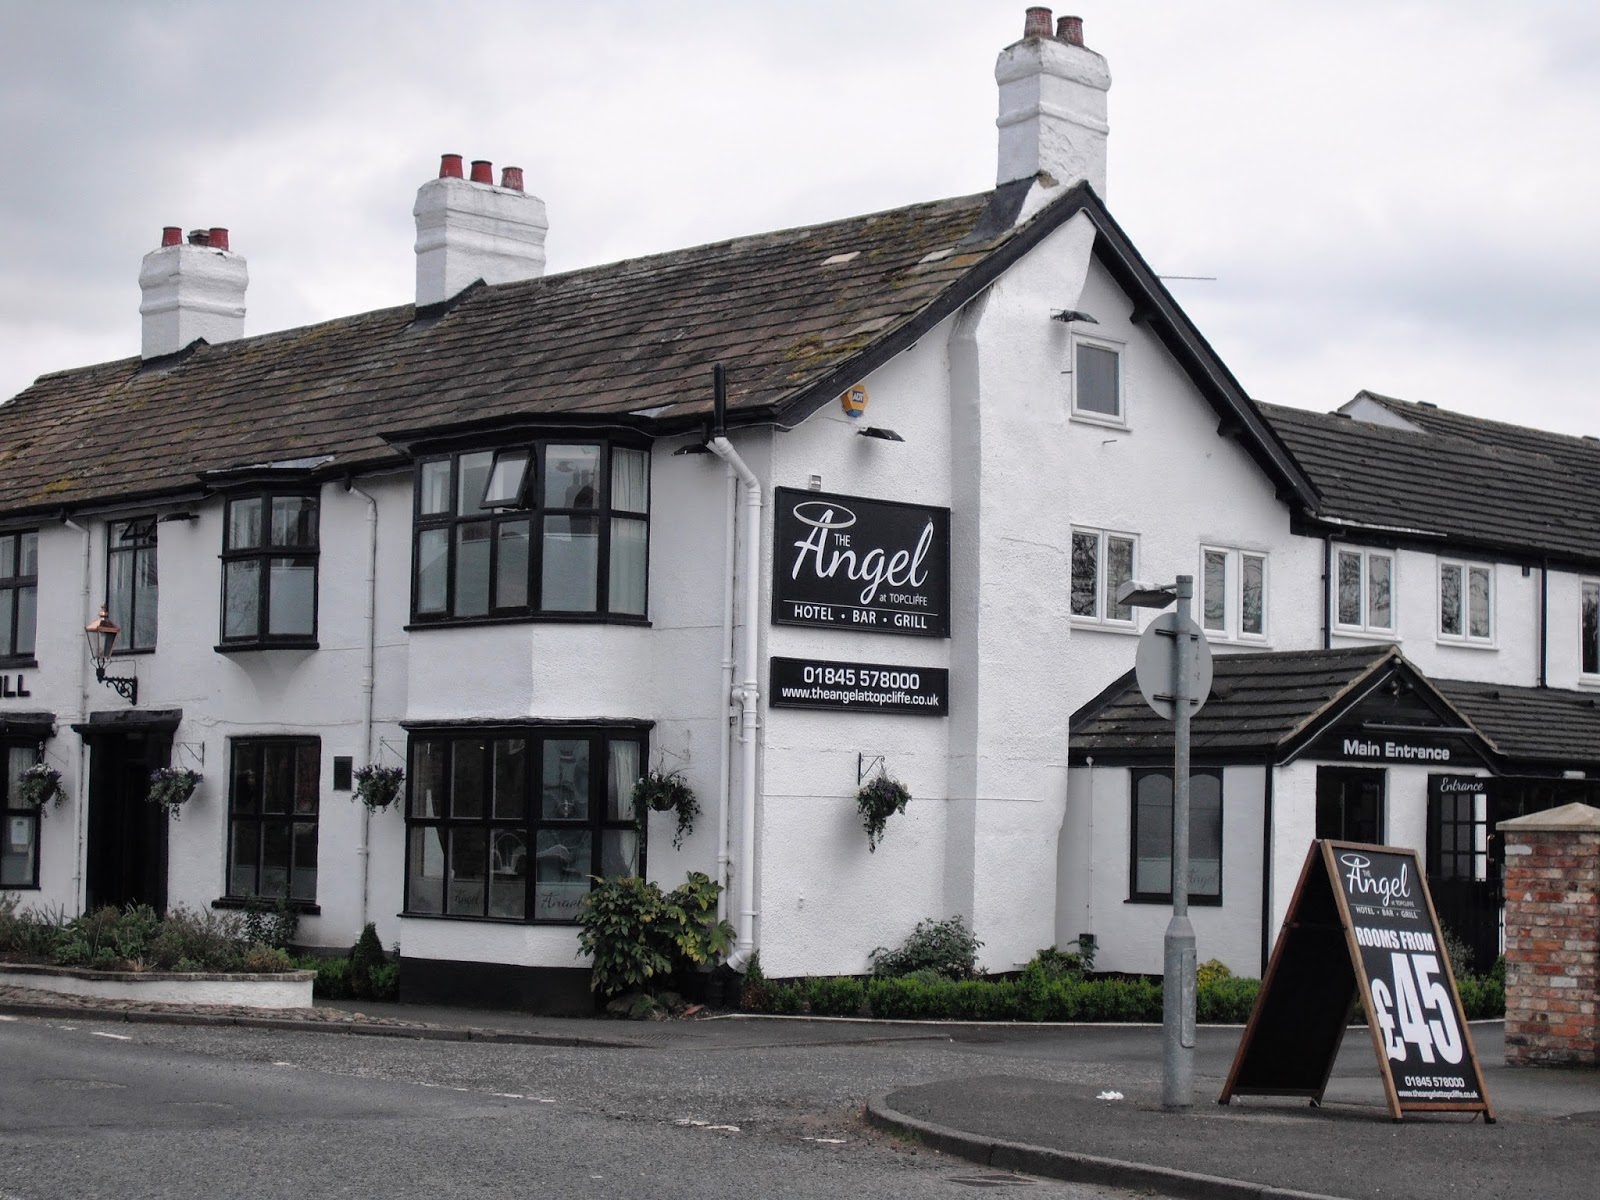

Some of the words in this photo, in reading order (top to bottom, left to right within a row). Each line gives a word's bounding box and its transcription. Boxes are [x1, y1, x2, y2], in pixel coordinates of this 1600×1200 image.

[852, 392, 864, 402] ADT
[834, 533, 851, 547] THE
[791, 509, 934, 605] Angel
[879, 593, 887, 602] at
[890, 593, 928, 606] TOPCLIFFE
[794, 605, 834, 620] HOTEL
[852, 609, 876, 624] BAR
[894, 613, 927, 629] GRILL
[803, 666, 856, 685] 01845
[860, 669, 920, 690] 578000
[782, 686, 939, 706] www.theangelattopcliffe.co.uk
[1344, 739, 1380, 757] Main
[1385, 741, 1450, 760] Entrance
[1440, 776, 1483, 793] Entrance
[1346, 857, 1411, 907] Angel
[1362, 869, 1372, 878] THE
[1355, 906, 1375, 916] HOTEL
[1381, 909, 1394, 918] BAR
[1400, 910, 1418, 919] GRILL
[1355, 926, 1400, 949] ROOMS
[1400, 931, 1436, 951] FROM
[1371, 952, 1463, 1065] £45
[1404, 1075, 1433, 1087] 01845
[1432, 1076, 1465, 1088] 578000
